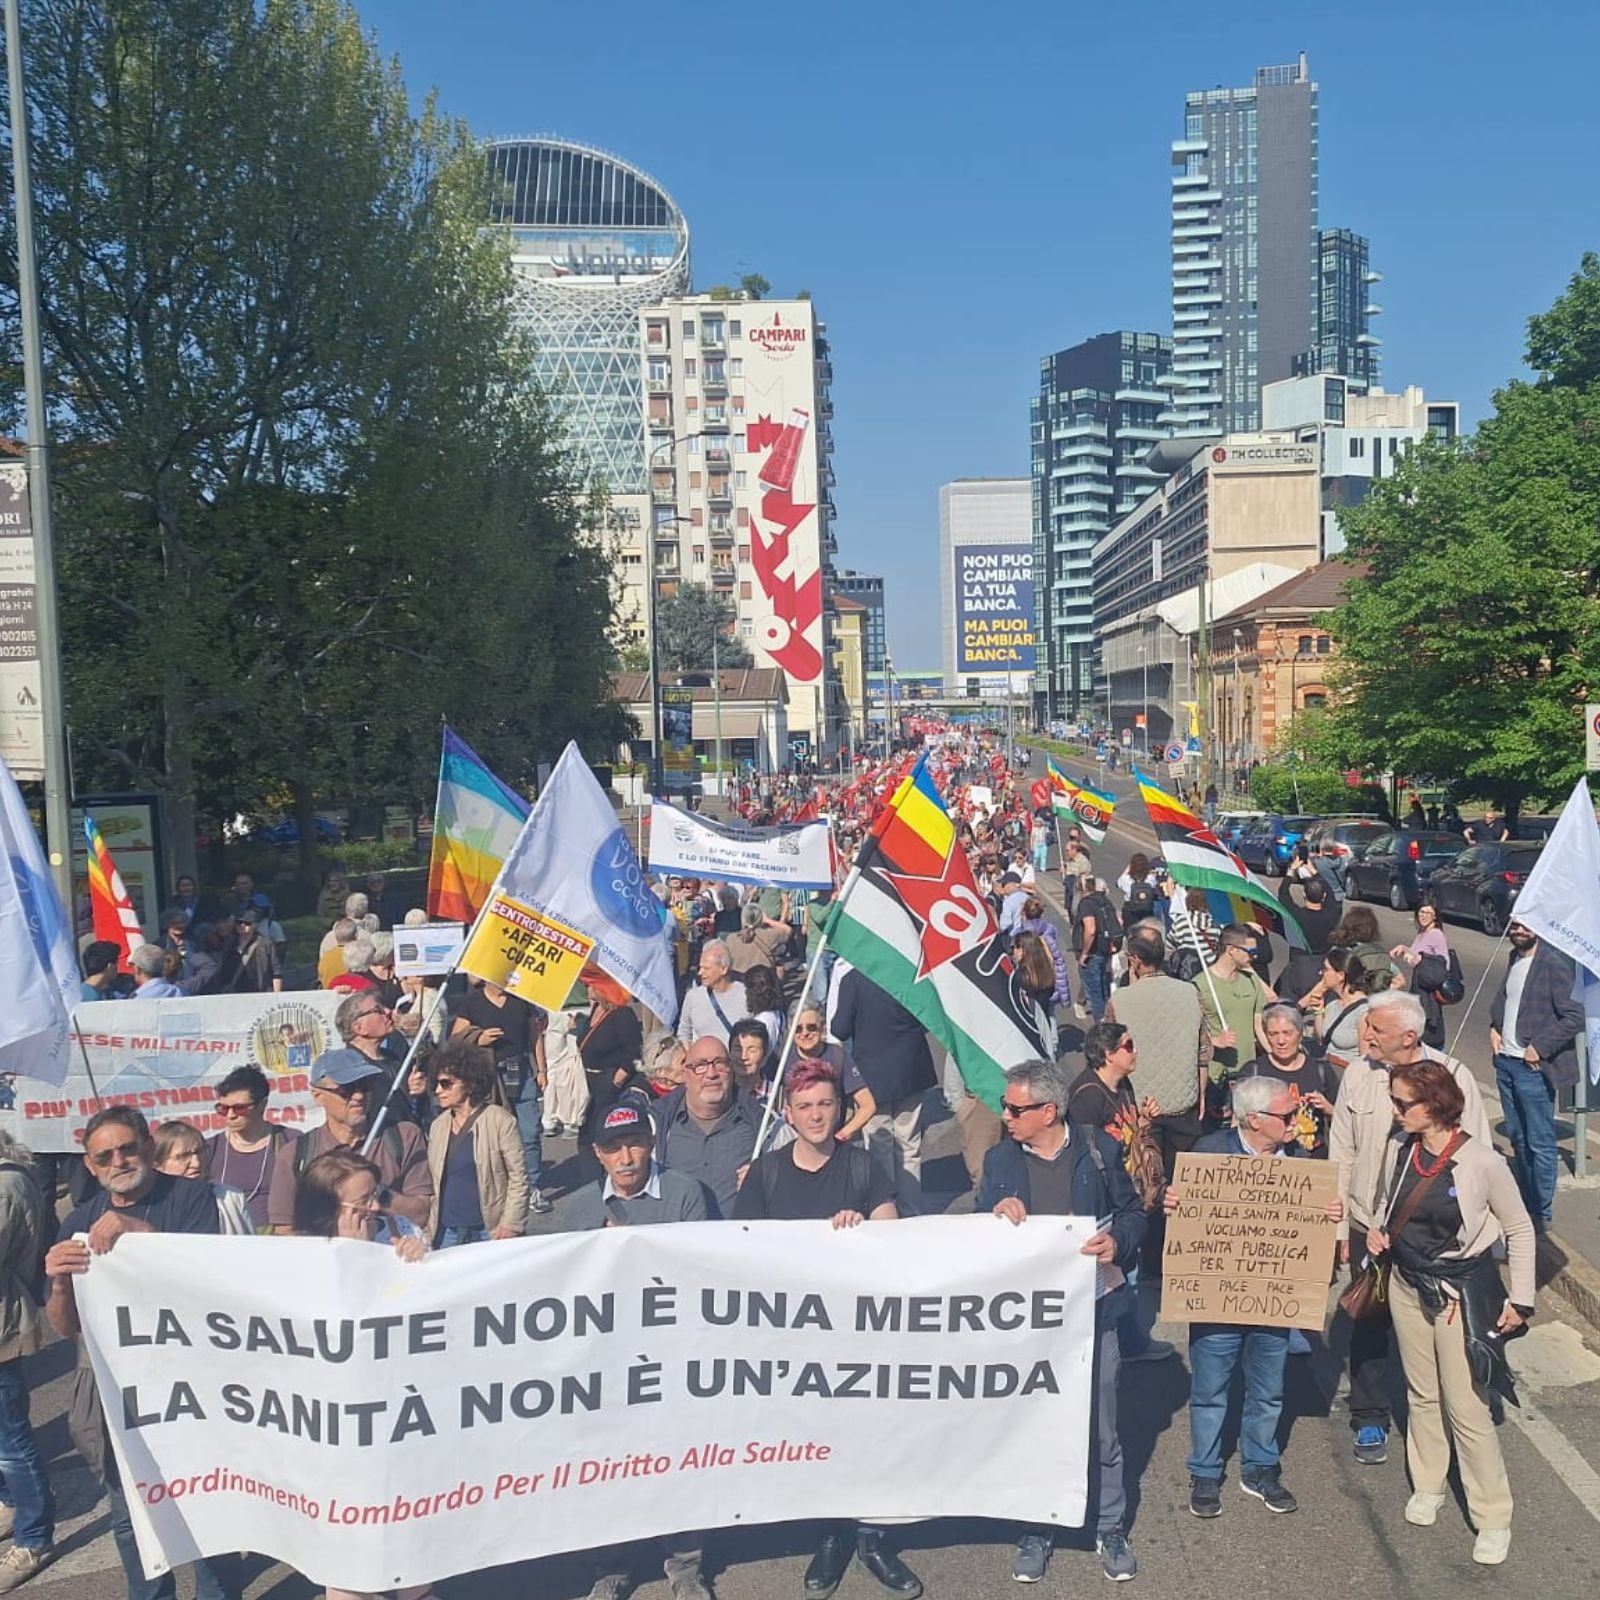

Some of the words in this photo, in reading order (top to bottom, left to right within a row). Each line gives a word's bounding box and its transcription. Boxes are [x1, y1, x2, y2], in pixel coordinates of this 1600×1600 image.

[749, 328, 806, 342] CAMPARI
[963, 555, 998, 568] NON
[1001, 554, 1033, 567] PUO
[963, 569, 1034, 582] CAMBIAR
[964, 585, 983, 597] LA
[986, 584, 1016, 596] TUA
[964, 599, 1021, 612] BANCA.
[965, 620, 989, 632] MA
[992, 619, 1028, 631] PUOI
[965, 634, 1035, 647] CAMBIAR
[965, 649, 1022, 661] BANCA.
[490, 900, 585, 957] CENTRODESTRA:
[501, 926, 564, 964] +AFFARI
[501, 946, 545, 976] -CURA
[131, 1037, 240, 1054] MILITARI!
[1221, 1155, 1282, 1173] STOP
[1208, 1206, 1238, 1219] ALLA
[1205, 1223, 1266, 1237] VOGLIAMO
[1270, 1228, 1298, 1239] SOLO
[1166, 1240, 1182, 1256] LA
[1241, 1242, 1308, 1262] PUBBLICA
[1200, 1256, 1224, 1271] PER
[1235, 1258, 1286, 1275] TUTTI
[1169, 1278, 1200, 1292] PACE
[1219, 1279, 1248, 1292] PACE
[1267, 1281, 1294, 1295] PACE
[1186, 1298, 1206, 1311] NEL
[1223, 1295, 1300, 1319] MONDO
[116, 1306, 192, 1347] LA
[206, 1310, 447, 1364] SALUTE
[474, 1292, 615, 1348] NON
[641, 1276, 677, 1328] È
[701, 1288, 833, 1331] UNA
[855, 1290, 1065, 1333] MERCE
[122, 1381, 207, 1430] LA
[221, 1383, 437, 1447] SANITÀ
[460, 1371, 602, 1429] NON
[627, 1354, 662, 1406] È
[686, 1358, 1061, 1401] UN'AZIENDA
[327, 1481, 484, 1526] Lombardo
[493, 1472, 544, 1500] Per
[551, 1462, 571, 1489] Il
[578, 1452, 672, 1485] Diritto
[679, 1443, 735, 1471] Alla
[743, 1439, 832, 1464] Salute
